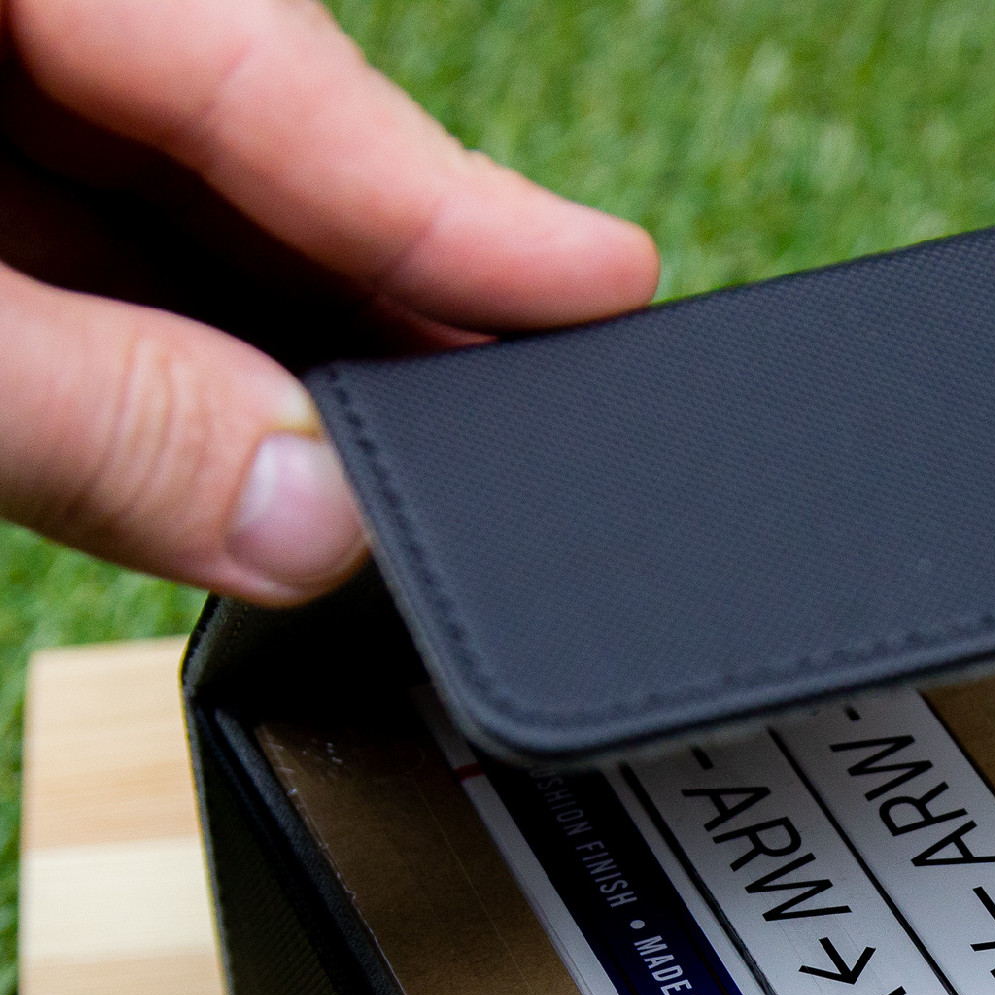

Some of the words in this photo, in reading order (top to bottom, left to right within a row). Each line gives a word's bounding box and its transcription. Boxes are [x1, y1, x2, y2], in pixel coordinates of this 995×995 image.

[528, 768, 593, 836] USHION
[575, 840, 638, 908] FINISH
[633, 935, 692, 995] MADE
[681, 786, 853, 922] ARW
